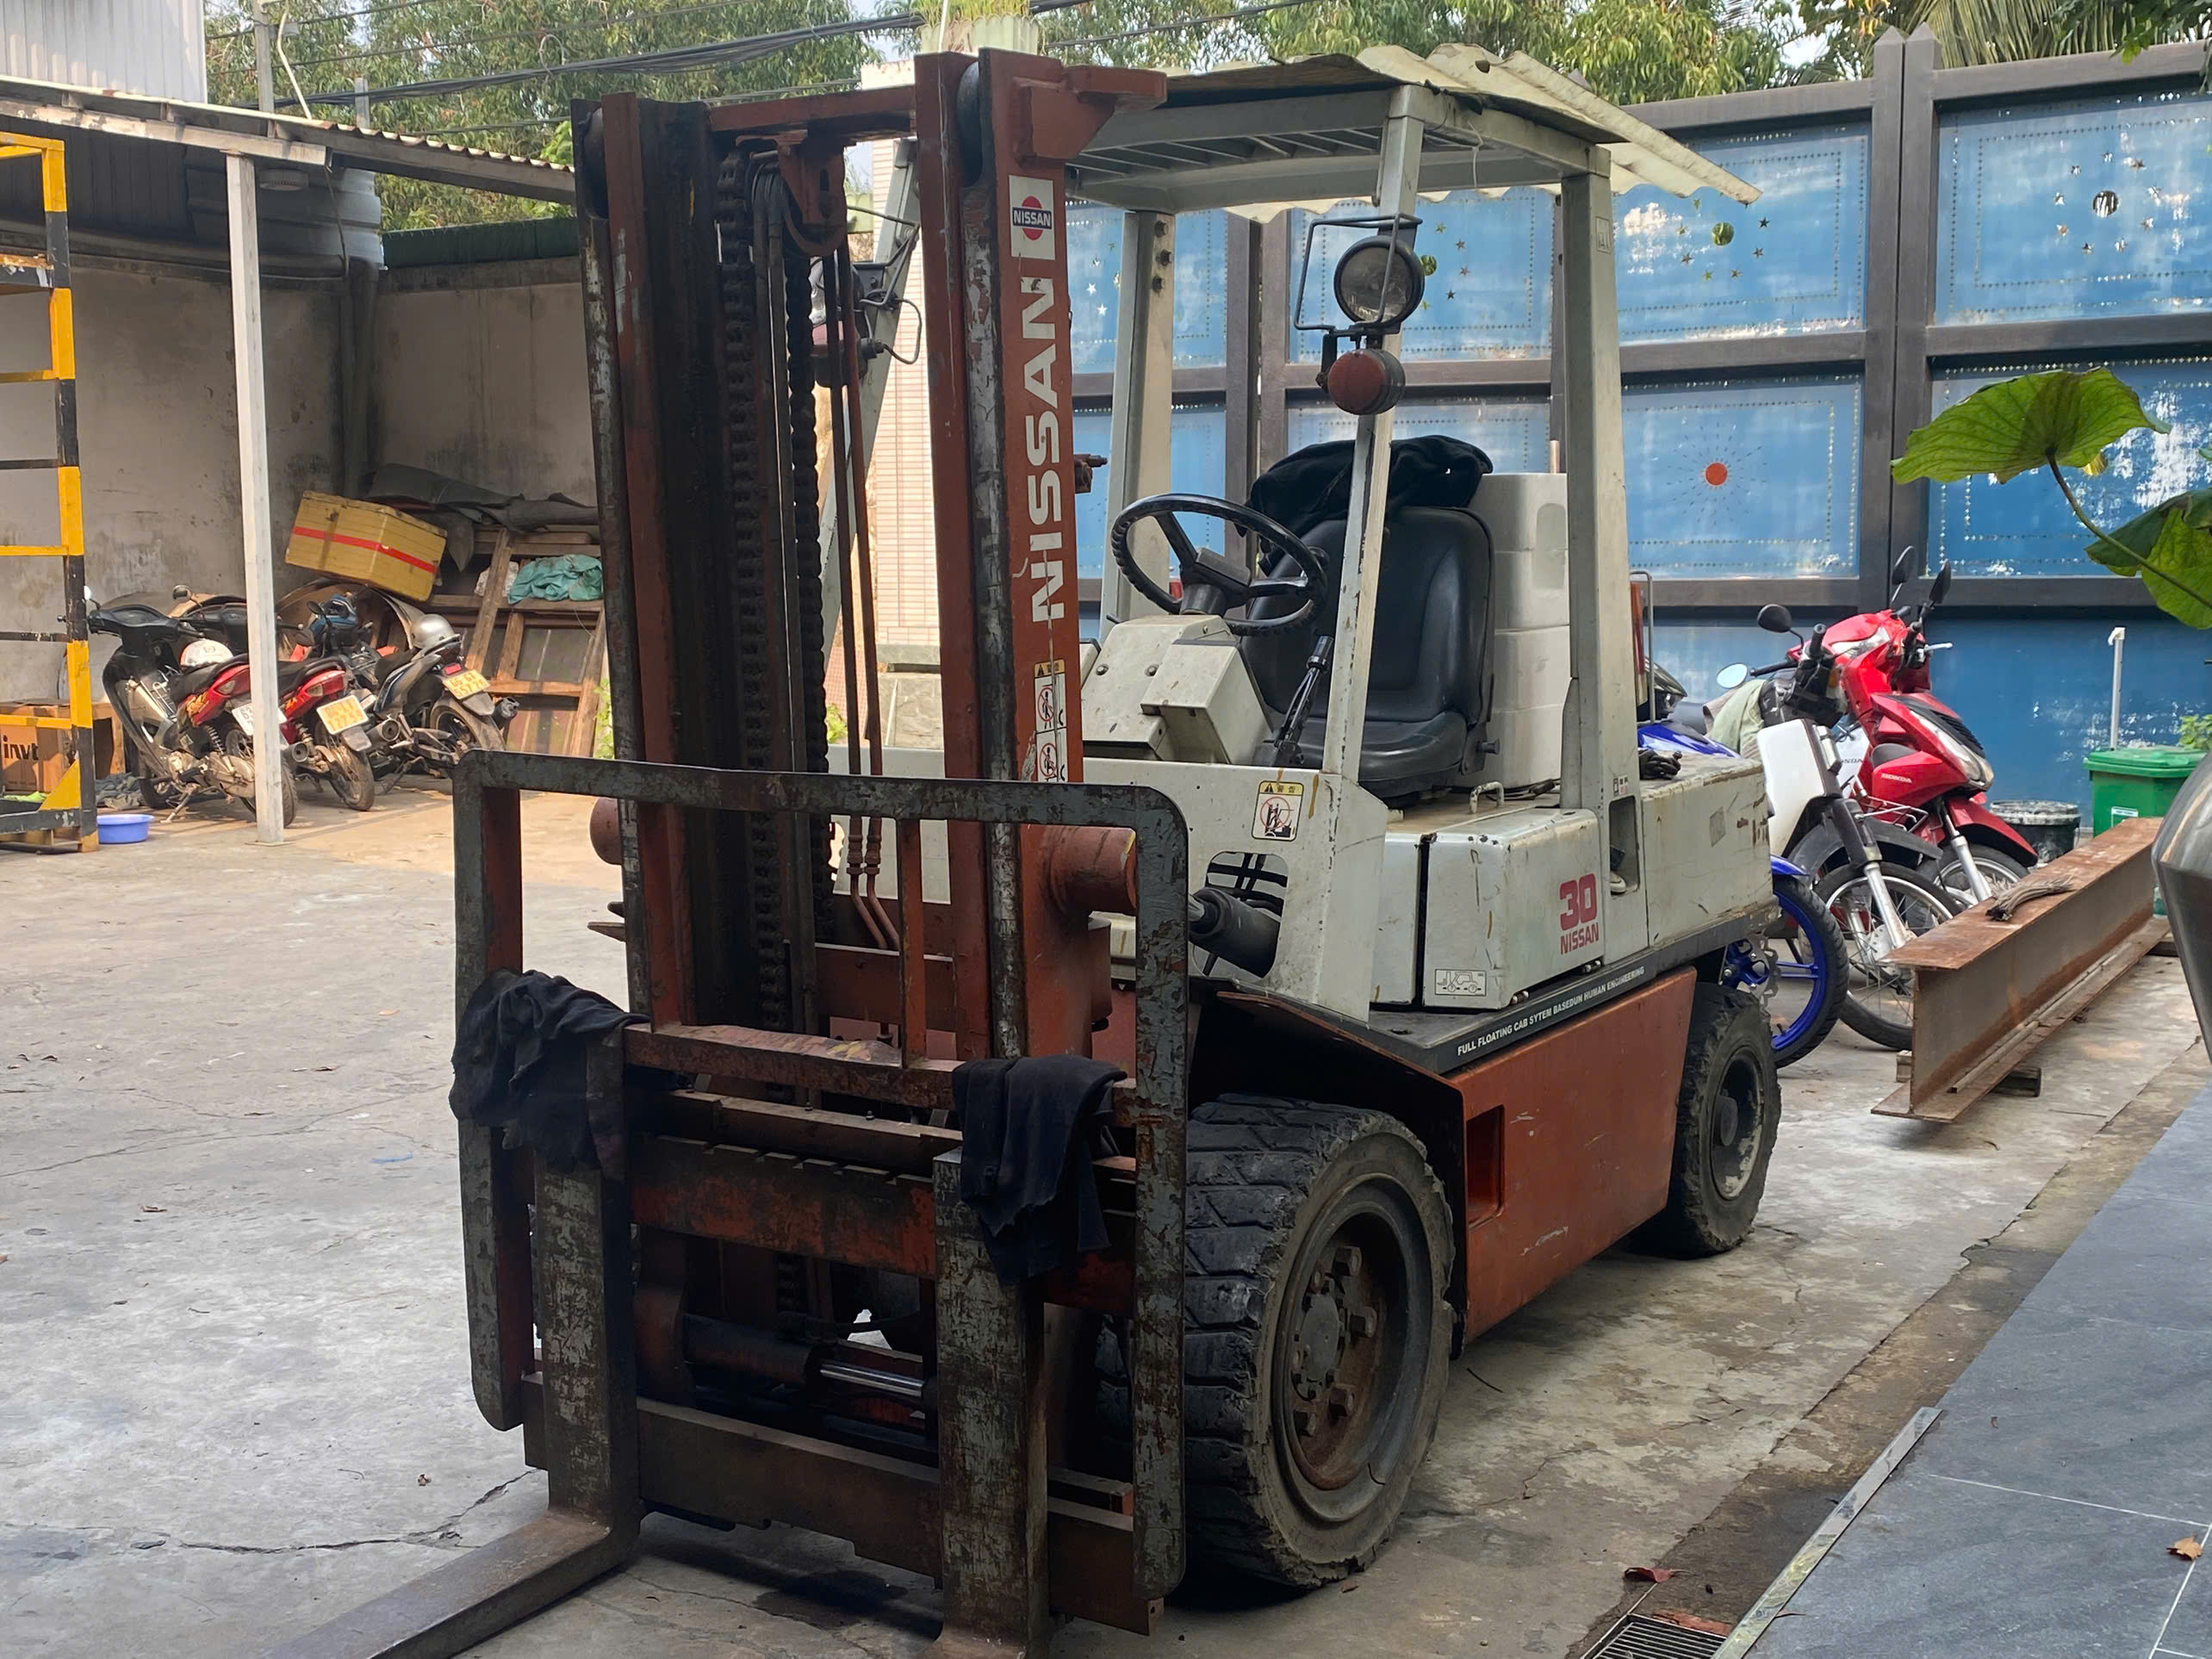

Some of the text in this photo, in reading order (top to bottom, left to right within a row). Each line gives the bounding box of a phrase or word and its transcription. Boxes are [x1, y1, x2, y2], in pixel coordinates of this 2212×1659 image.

[1013, 209, 1051, 227] NISSAN
[1021, 276, 1065, 622] NISSAN
[3, 735, 39, 761] invt
[1560, 873, 1598, 931] 30
[1560, 923, 1600, 955] NISSAN
[1457, 1041, 1477, 1056] FULL
[1477, 1024, 1513, 1047] FLOATING
[1513, 1018, 1528, 1031] CAB
[1583, 984, 1606, 1001] HUMAN
